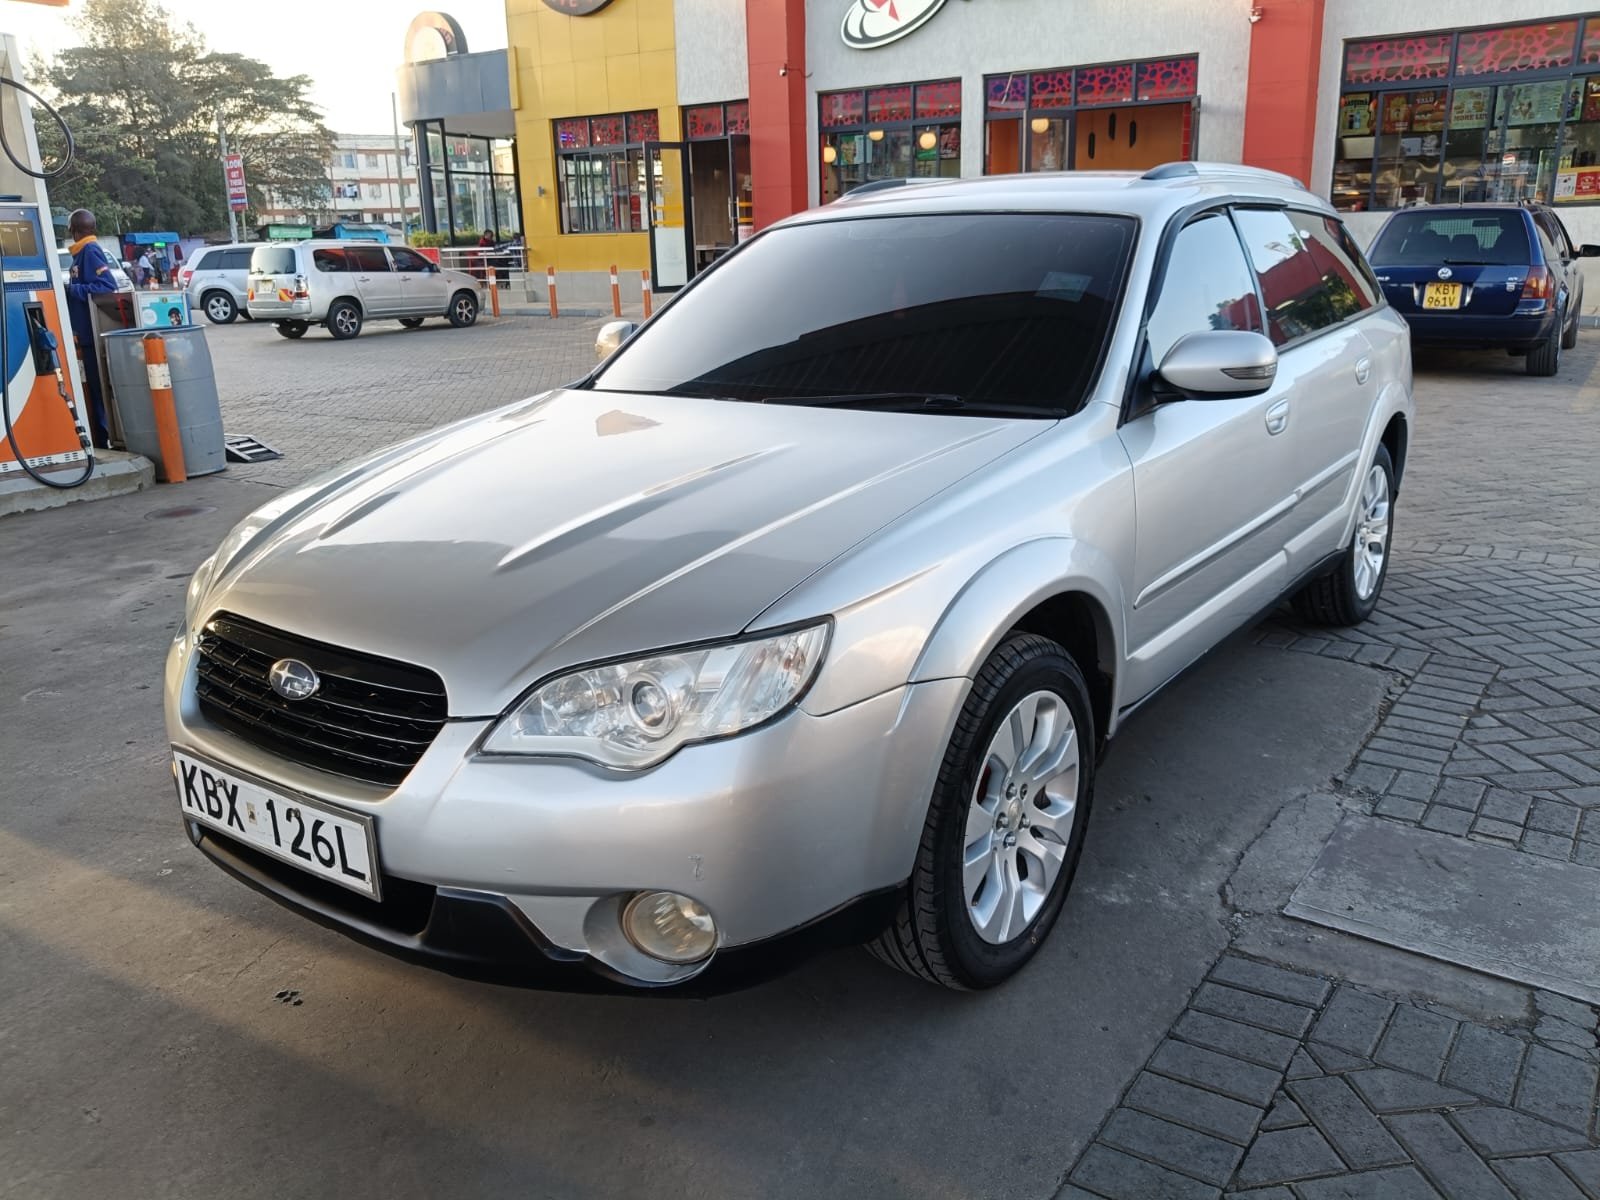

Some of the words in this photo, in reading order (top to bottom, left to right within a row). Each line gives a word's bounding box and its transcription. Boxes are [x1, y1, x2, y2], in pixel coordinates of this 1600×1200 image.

[1435, 284, 1459, 295] KBT
[1427, 296, 1456, 307] 961V
[180, 760, 247, 833] KBX
[266, 798, 366, 881] 126L
